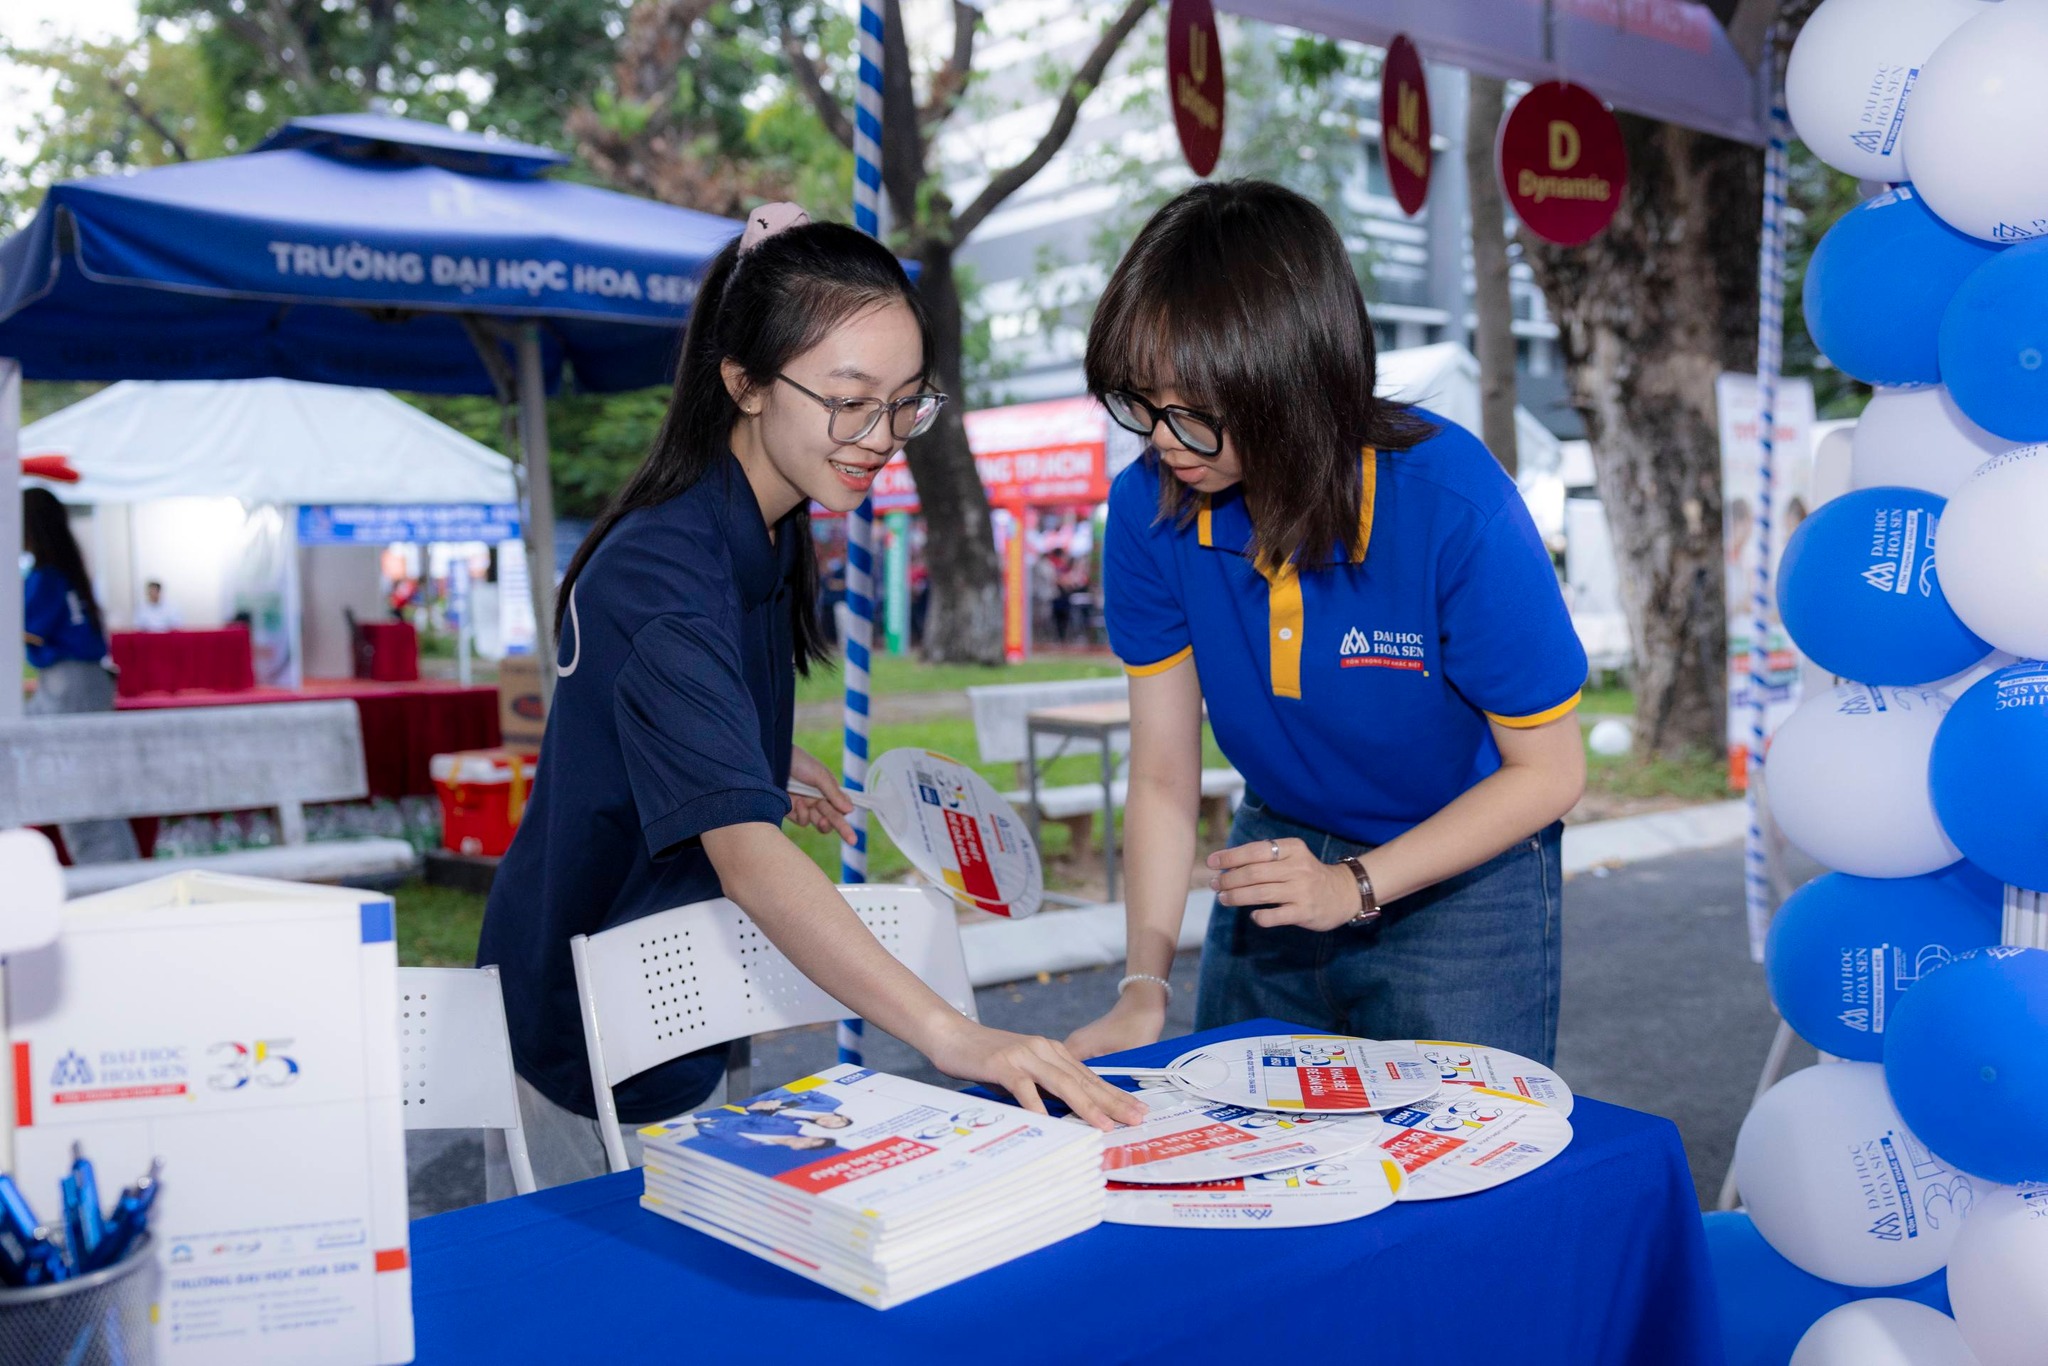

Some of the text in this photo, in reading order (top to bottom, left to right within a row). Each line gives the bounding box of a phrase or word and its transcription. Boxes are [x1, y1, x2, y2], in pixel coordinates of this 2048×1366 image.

[1189, 22, 1208, 84] U
[1398, 80, 1418, 141] M
[1548, 120, 1580, 171] D
[1518, 168, 1611, 204] Dynamic
[268, 241, 424, 283] TRƯỜNG
[431, 254, 490, 294] ĐẠI
[498, 257, 567, 296] HỌC
[573, 264, 642, 299] HOA
[1886, 508, 1902, 558] HOA SEN
[1374, 643, 1424, 658] HOA SEN
[1996, 686, 2028, 699] SEN
[1856, 948, 1868, 1004] HOA SEN
[206, 1038, 299, 1091] 35
[1390, 1110, 1414, 1124] HSU
[1414, 1136, 1450, 1155] KHÁC
[1863, 1140, 1896, 1207] HOA SEN
